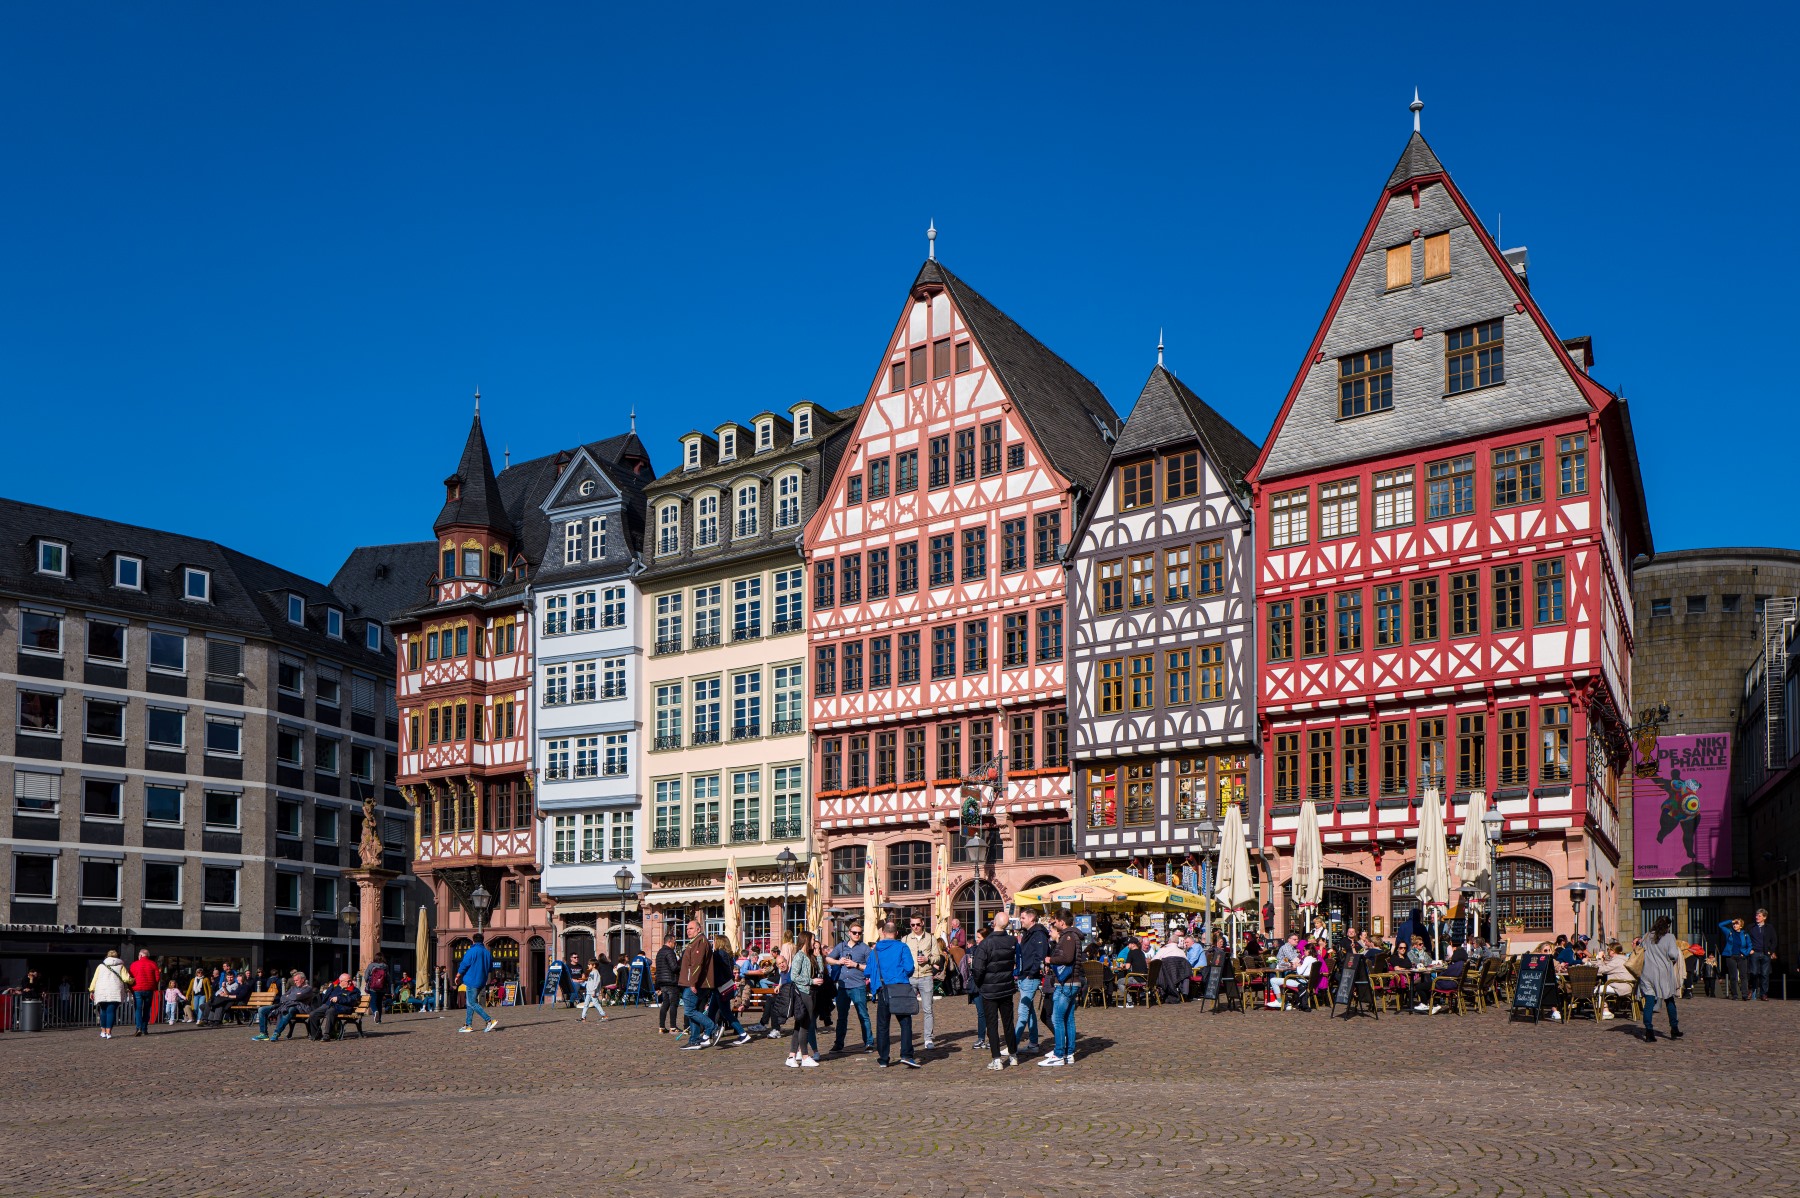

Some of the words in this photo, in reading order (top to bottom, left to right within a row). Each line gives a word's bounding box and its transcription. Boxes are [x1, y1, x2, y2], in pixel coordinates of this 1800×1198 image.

[1696, 736, 1727, 748] NIKI
[1659, 749, 1678, 759] DE
[1682, 747, 1726, 758] SAINT
[1671, 756, 1727, 768] PHALLE
[659, 874, 712, 889] Souvenirs
[1634, 888, 1665, 898] HIRN
[1666, 887, 1749, 897] KUNSTHALLE
[0, 924, 60, 932] INSTEIN
